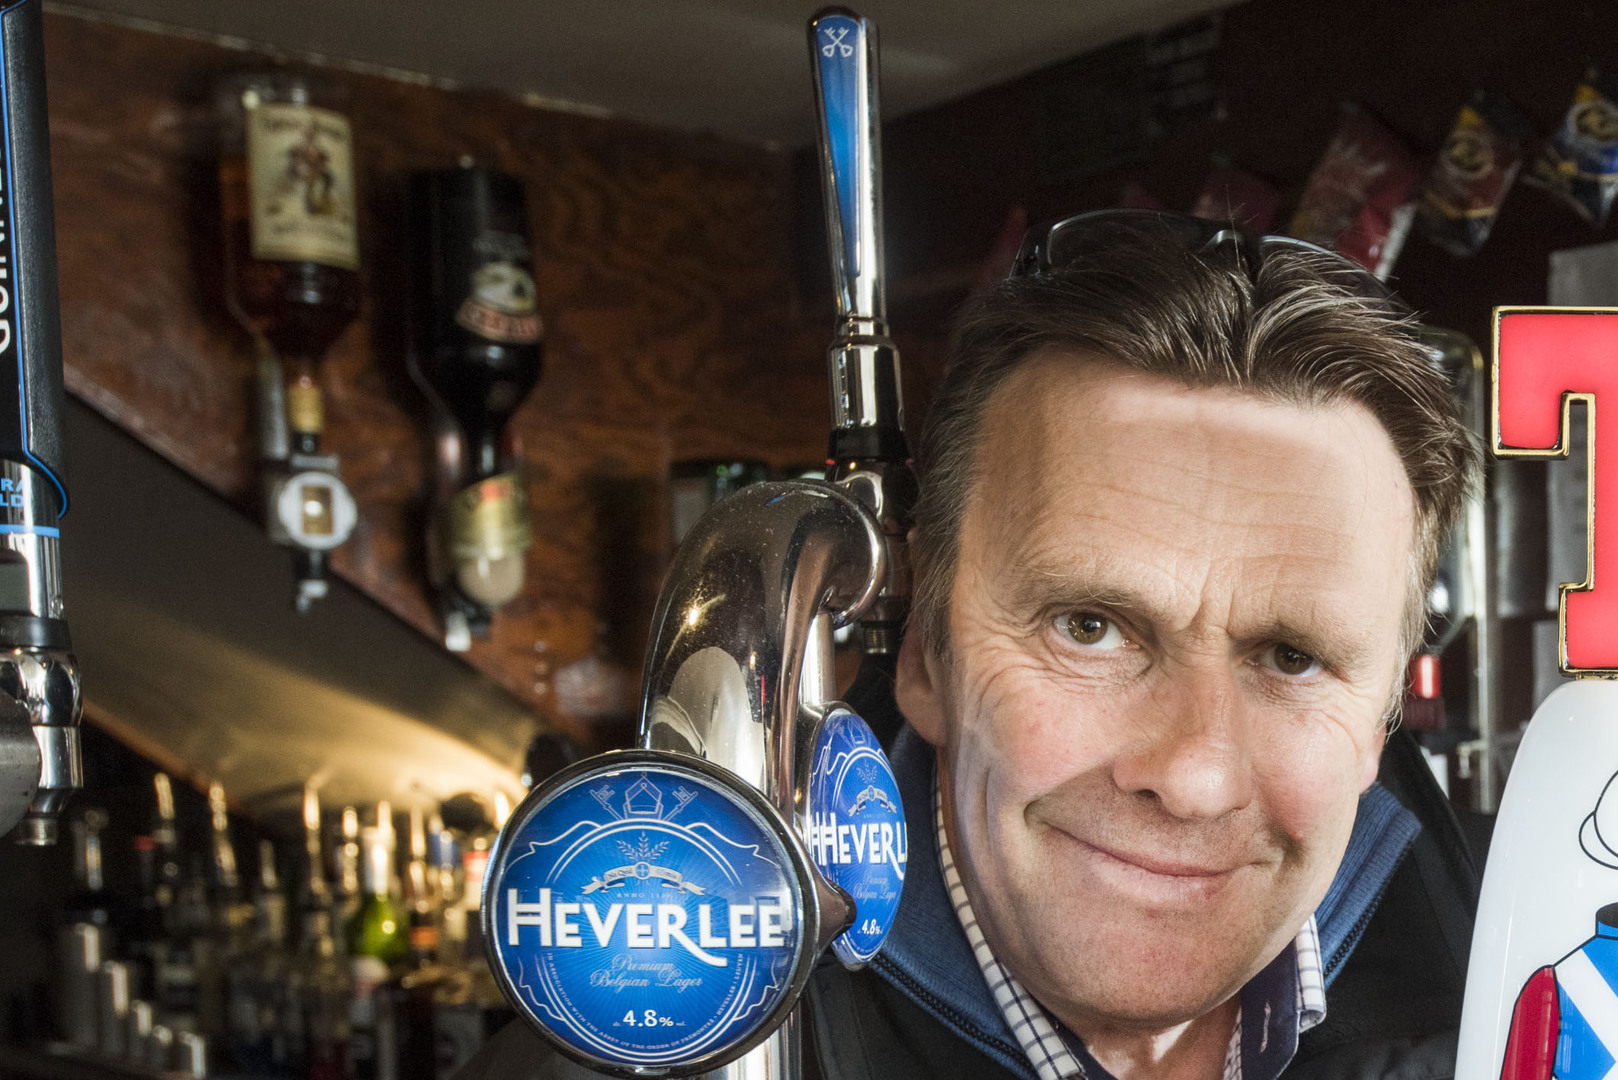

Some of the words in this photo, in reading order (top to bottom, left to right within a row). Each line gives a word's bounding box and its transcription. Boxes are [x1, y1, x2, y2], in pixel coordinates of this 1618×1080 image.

[820, 811, 908, 882] HEVERL
[507, 887, 785, 968] HEVERLEE
[611, 953, 675, 972] Premium
[589, 969, 651, 994] Belgian
[654, 968, 703, 994] Lager
[622, 1009, 675, 1028] 4.8%
